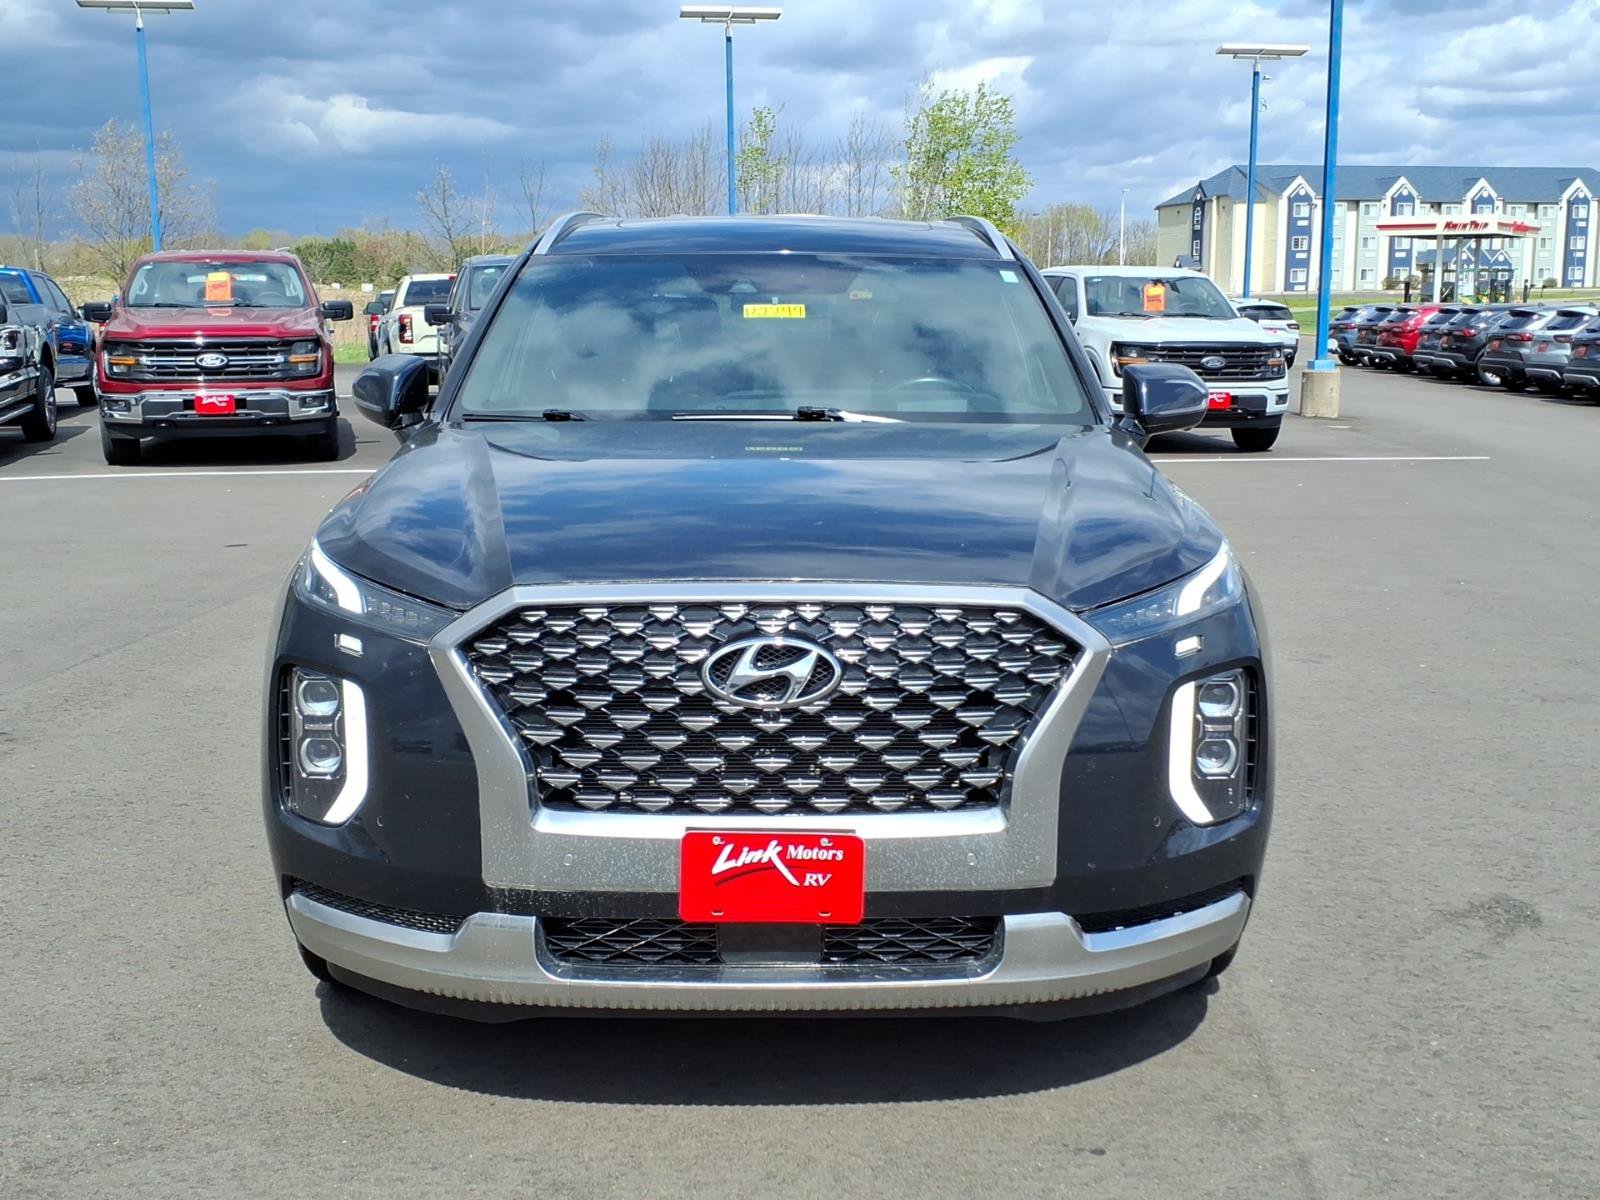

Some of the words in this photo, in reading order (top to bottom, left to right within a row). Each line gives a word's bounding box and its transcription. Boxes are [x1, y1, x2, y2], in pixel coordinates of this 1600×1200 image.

[711, 839, 801, 886] Link
[786, 844, 844, 861] Motors
[803, 872, 833, 887] RV
